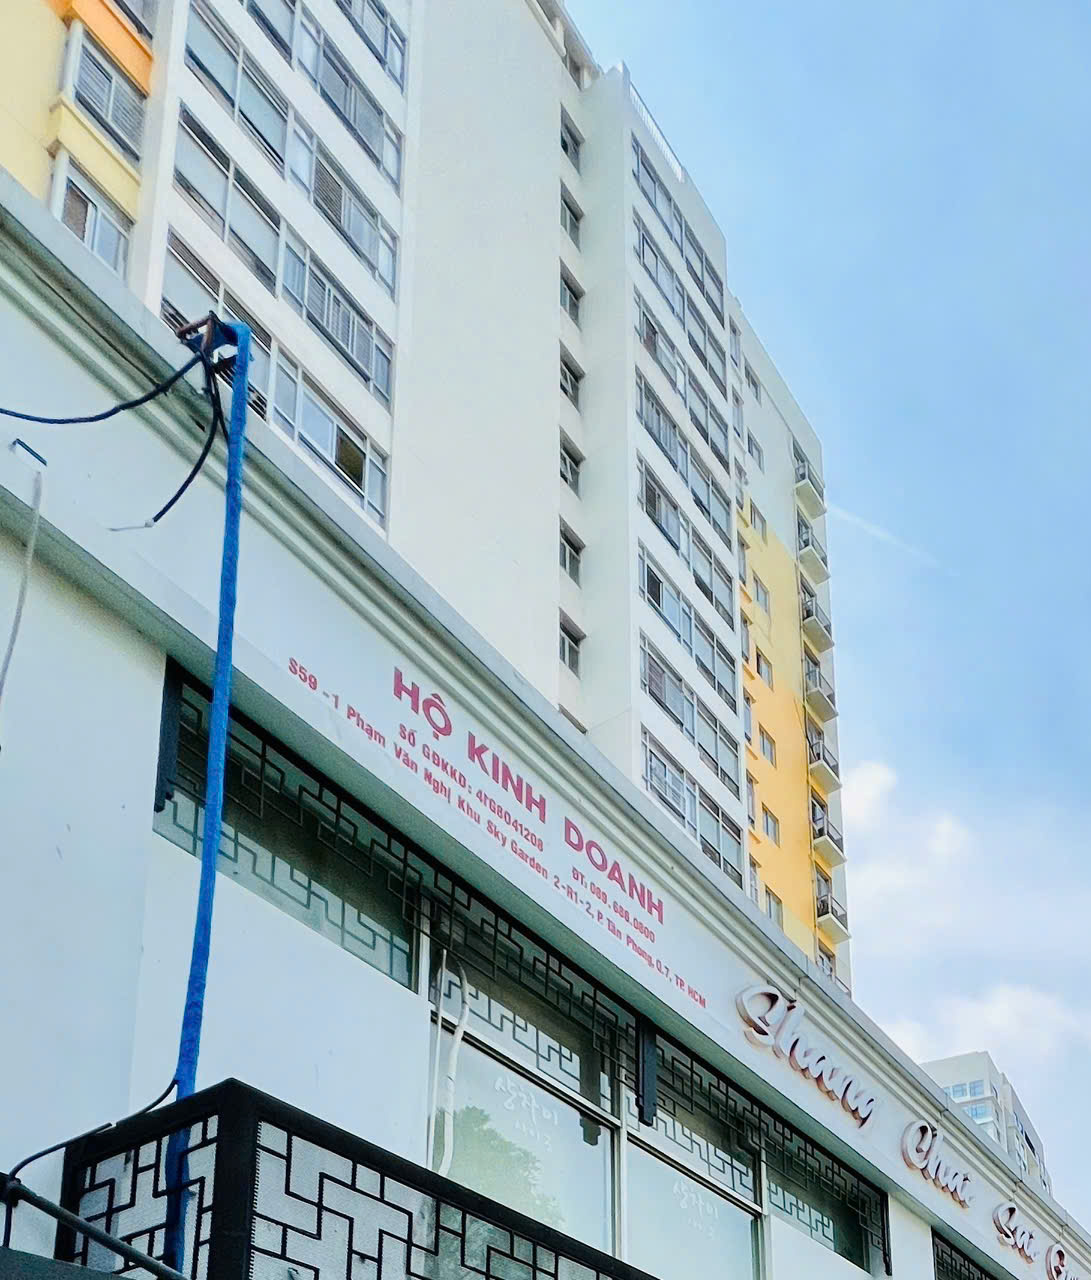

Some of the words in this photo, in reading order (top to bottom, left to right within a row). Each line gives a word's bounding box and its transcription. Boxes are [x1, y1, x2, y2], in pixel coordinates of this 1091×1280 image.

[288, 656, 317, 691] S59
[346, 703, 386, 748] Phạm
[393, 742, 418, 774] Văn
[423, 767, 452, 804] Nghị
[457, 794, 481, 825] Khu
[486, 819, 507, 848] Sky
[510, 839, 548, 880] Garden
[687, 984, 706, 1009] HCM
[393, 666, 453, 741] HỘ
[467, 731, 546, 824] KINH
[564, 816, 664, 925] DOANH
